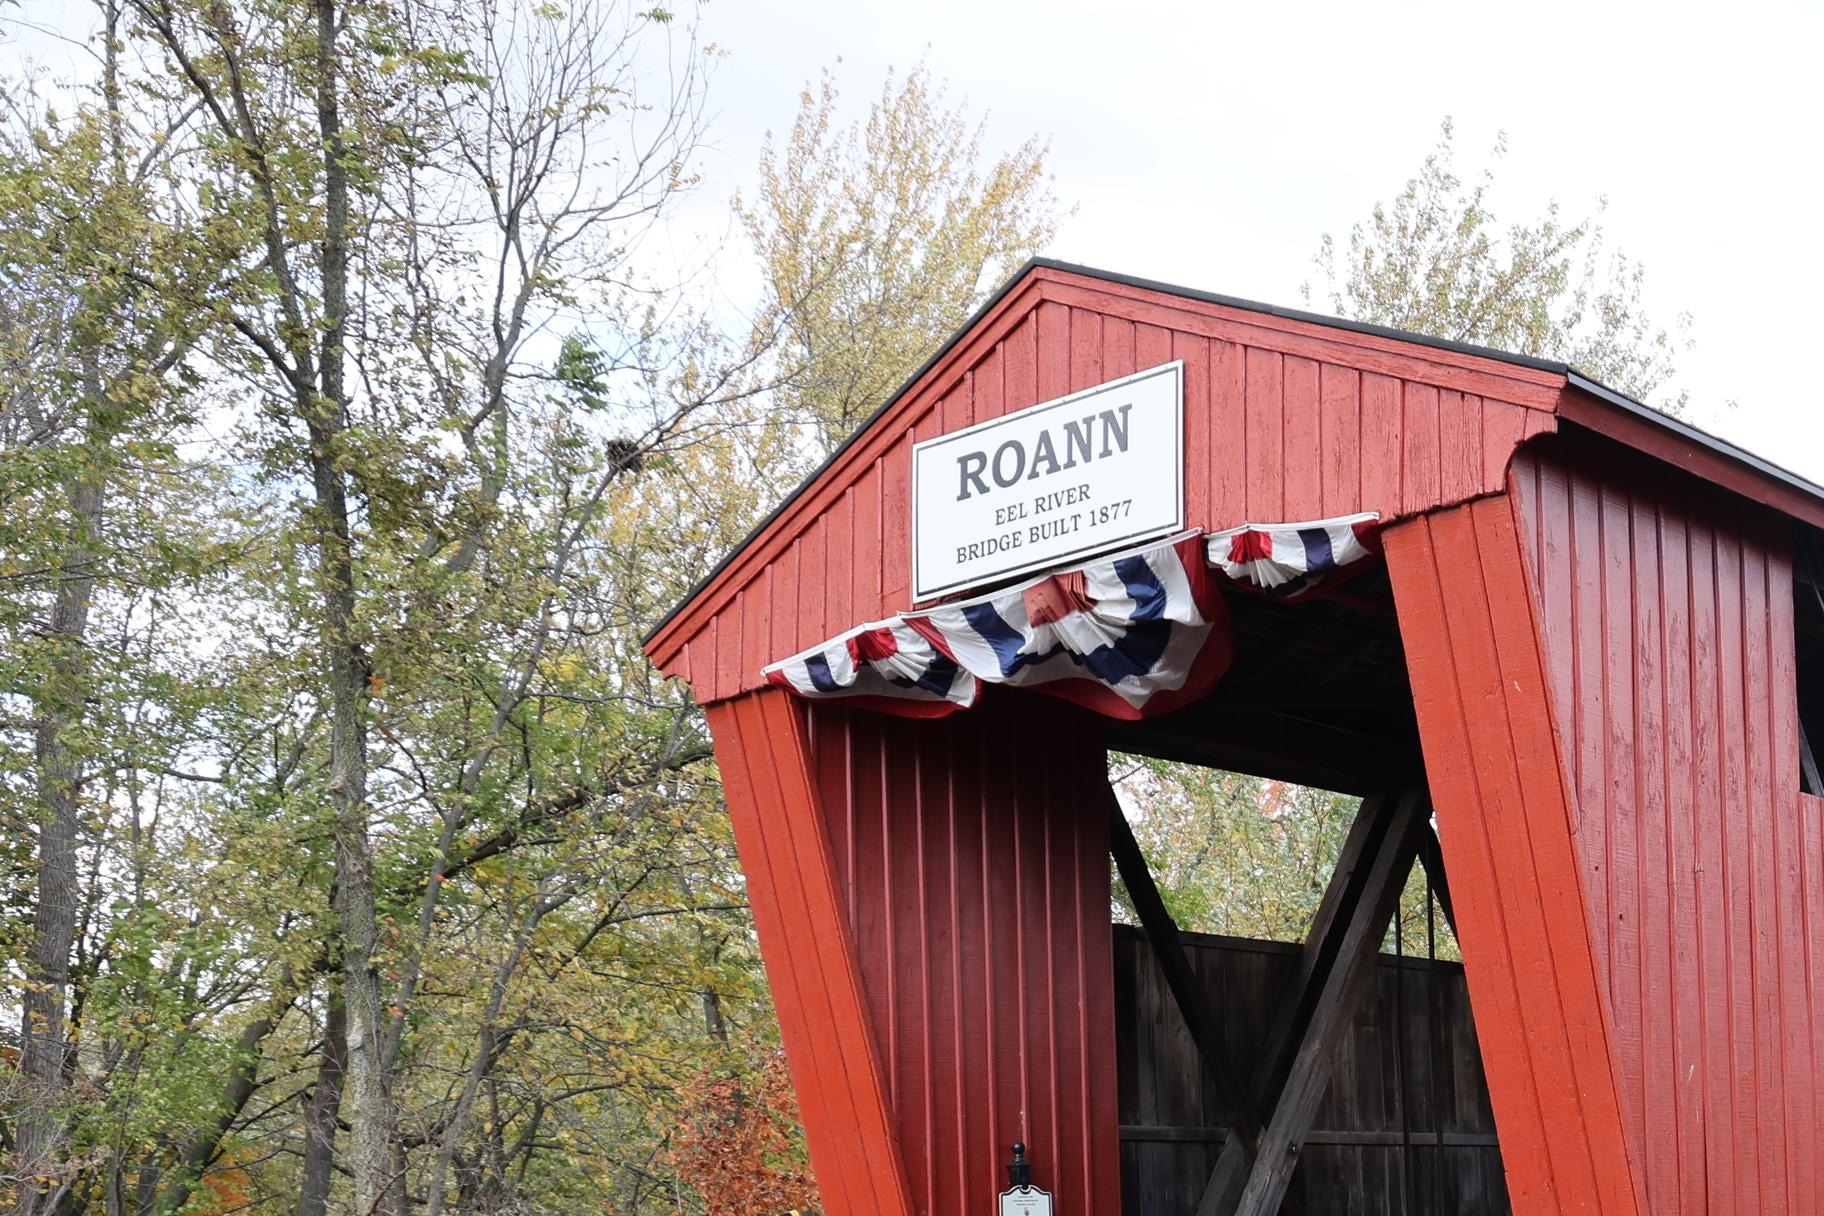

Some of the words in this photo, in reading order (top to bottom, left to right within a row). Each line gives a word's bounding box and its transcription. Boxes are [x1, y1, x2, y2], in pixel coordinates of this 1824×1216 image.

[956, 403, 1132, 501] ROANN
[956, 530, 1022, 564] BRIDGE
[1029, 514, 1080, 543] BUILT
[1089, 499, 1132, 527] 1877
[995, 502, 1028, 526] EEL
[1034, 484, 1090, 514] RIVER
